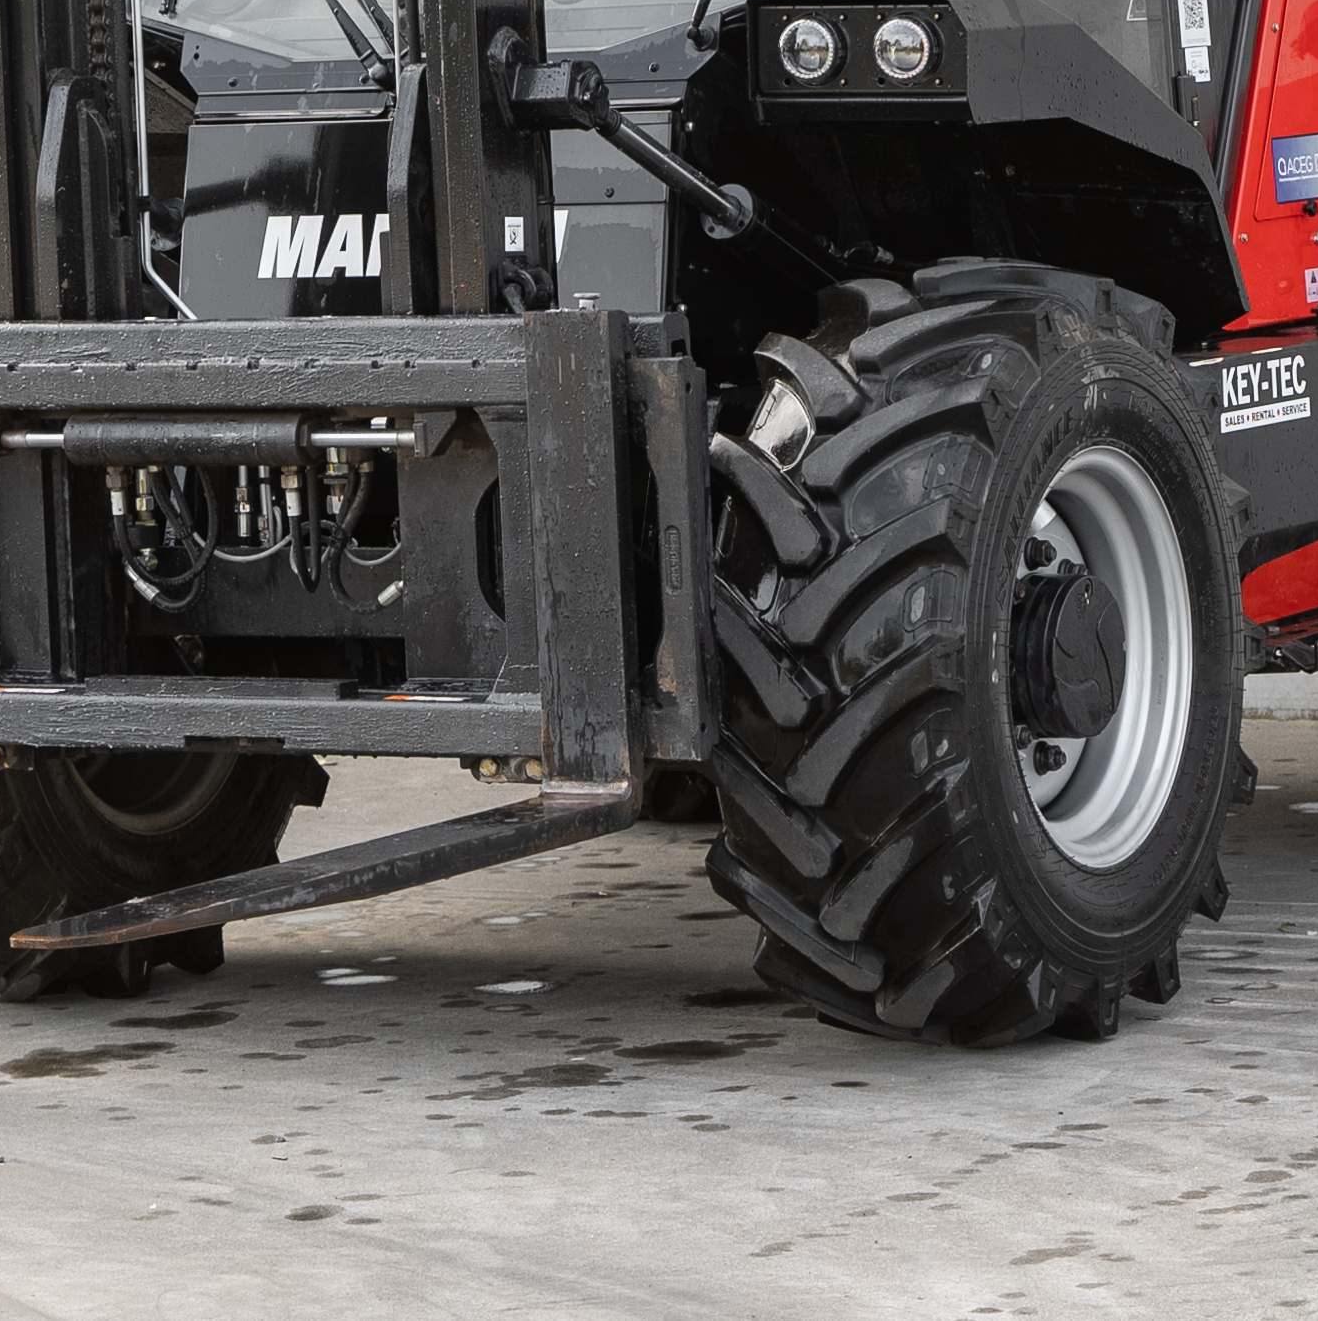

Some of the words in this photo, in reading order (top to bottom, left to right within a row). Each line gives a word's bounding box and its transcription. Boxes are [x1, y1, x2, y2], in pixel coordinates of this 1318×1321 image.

[1222, 355, 1307, 408] KEY-TEC
[1225, 414, 1245, 428] SALES
[1251, 409, 1276, 422] RENTAL
[1282, 402, 1308, 416] SERVICE
[1003, 406, 1075, 573] ALLIANCE
